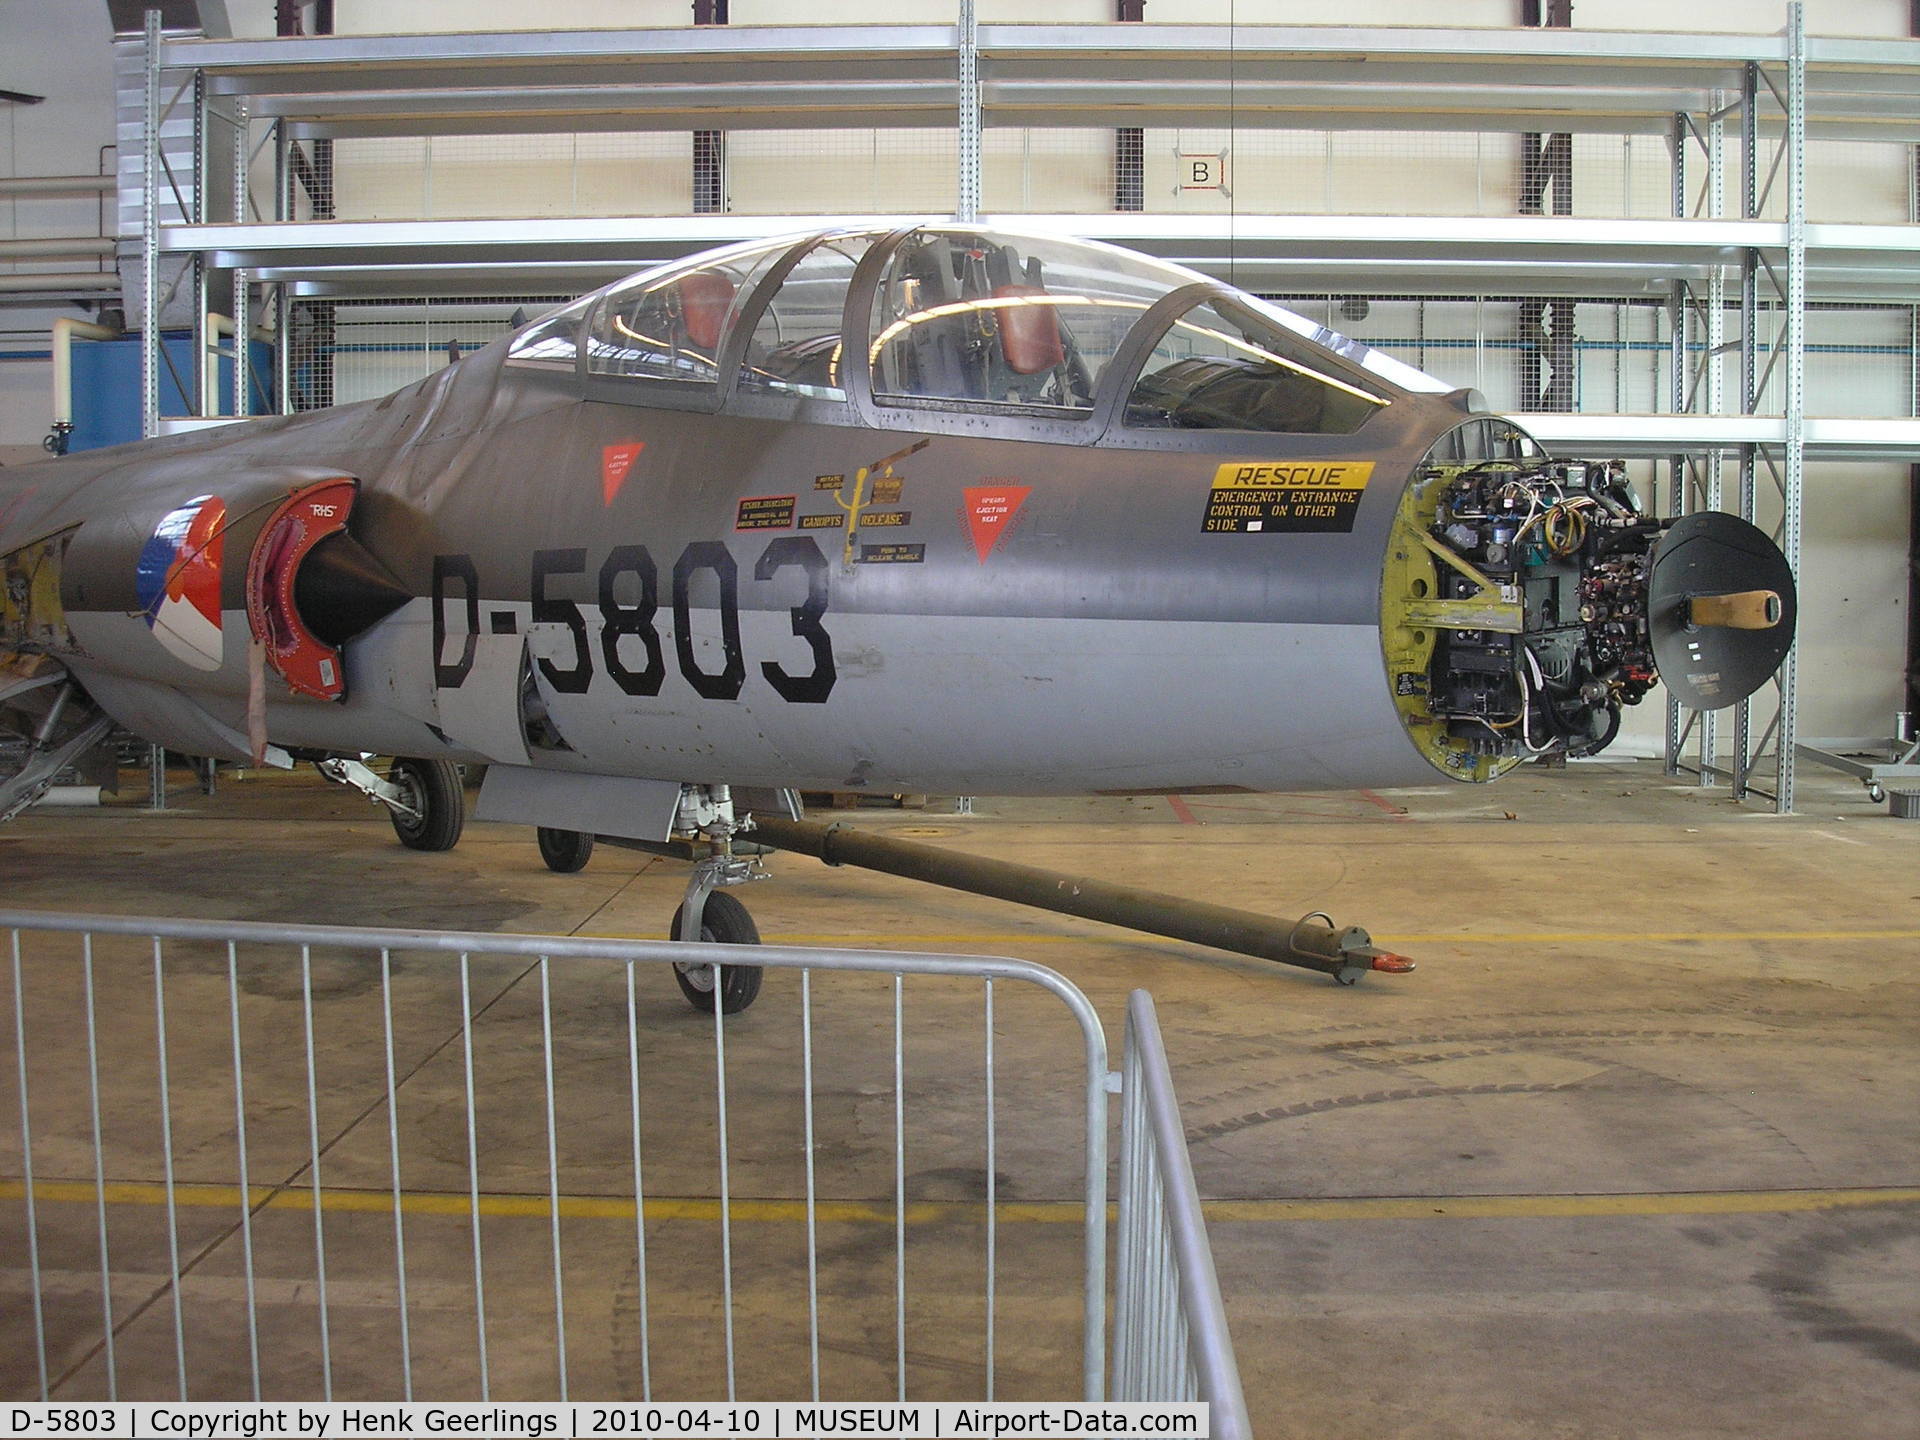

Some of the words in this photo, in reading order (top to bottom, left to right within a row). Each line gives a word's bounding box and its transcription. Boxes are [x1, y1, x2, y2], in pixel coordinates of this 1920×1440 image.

[1193, 162, 1209, 182] B
[1233, 467, 1347, 486] RESCUE
[1212, 491, 1285, 503] EMERGENCY
[1290, 491, 1358, 503] ENTRANCE
[1210, 504, 1263, 517] CONTROL
[1271, 505, 1288, 517] ON
[1294, 505, 1336, 517] OTHER
[861, 513, 903, 527] RELEASE
[1207, 519, 1238, 531] SIDE
[432, 536, 838, 704] D-5803
